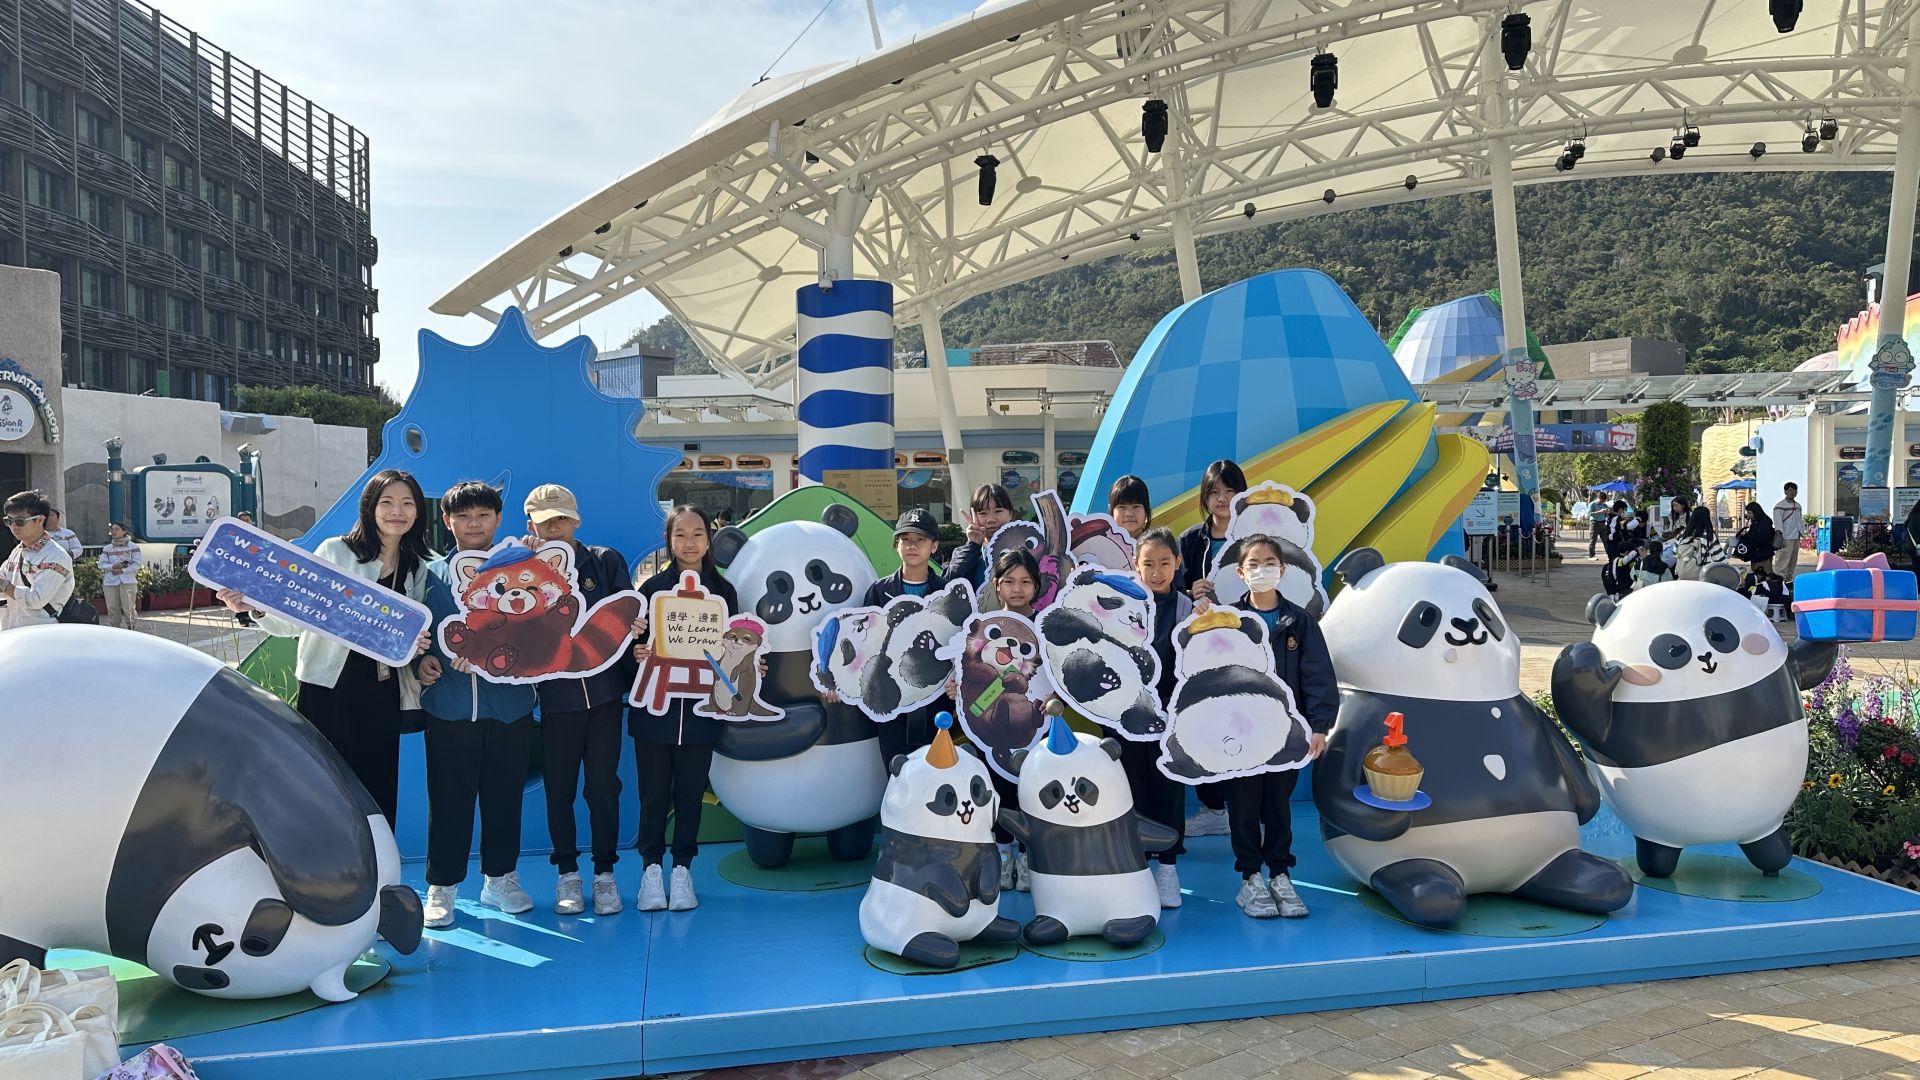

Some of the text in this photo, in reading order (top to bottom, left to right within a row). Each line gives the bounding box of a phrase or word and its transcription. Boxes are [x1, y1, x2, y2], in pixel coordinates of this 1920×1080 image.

[44, 403, 60, 443] KIOSK
[911, 514, 920, 522] R
[267, 551, 319, 582] Learn
[330, 579, 353, 599] We
[215, 548, 405, 638] Ocean Park Drawing Competition
[284, 597, 328, 621] 2025/26
[668, 623, 721, 634] We Learn
[668, 635, 717, 645] We Draw
[1382, 711, 1408, 746] 1
